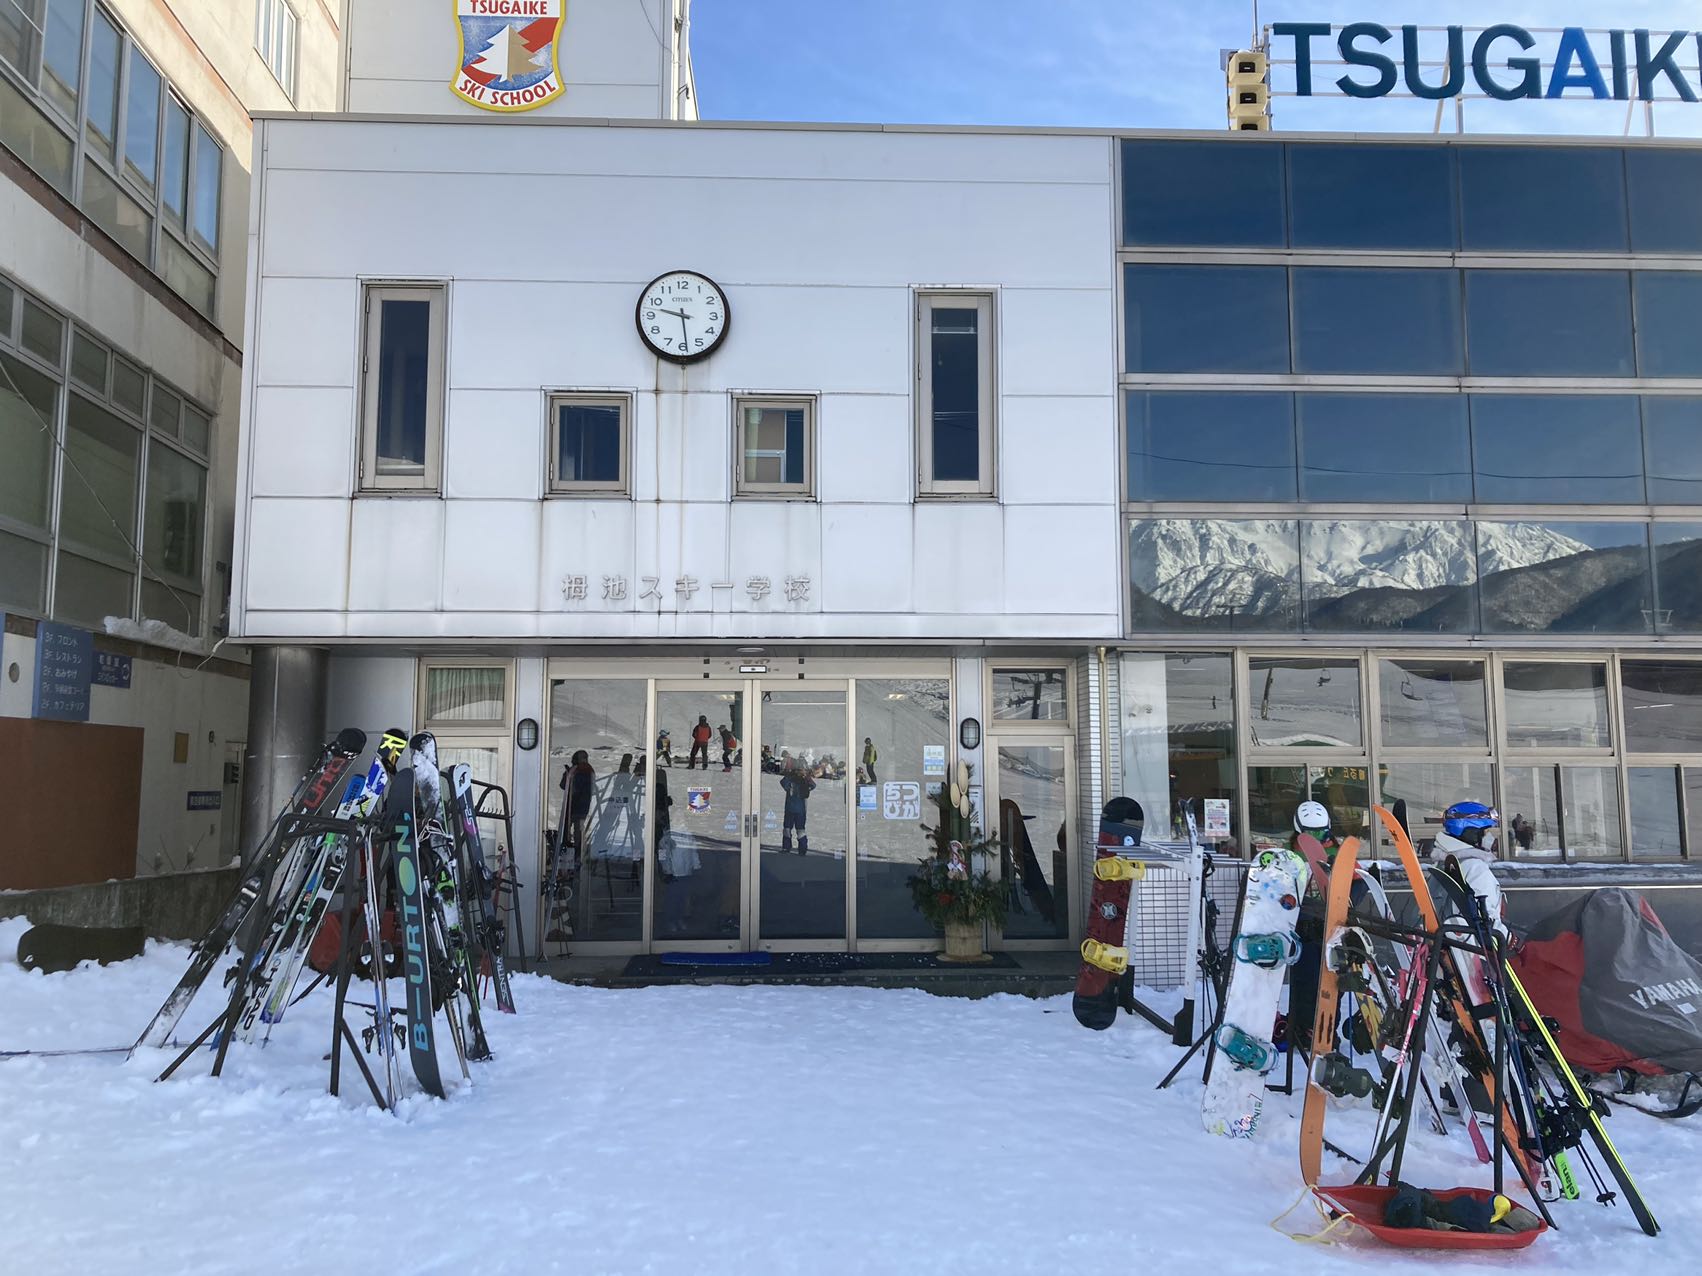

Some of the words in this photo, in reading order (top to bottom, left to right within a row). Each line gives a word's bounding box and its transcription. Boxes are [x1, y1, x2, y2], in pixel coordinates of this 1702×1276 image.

[470, 0, 547, 15] TSUGAIKE
[1273, 22, 1702, 102] TSUGAIK
[459, 79, 486, 101] SKI
[490, 80, 556, 106] SCHOOL
[661, 285, 671, 294] 11
[677, 281, 689, 290] 12
[650, 297, 663, 306] 10
[706, 296, 715, 305] 2
[646, 311, 655, 320] 9
[709, 312, 718, 320] 3
[651, 326, 660, 334] 8
[705, 326, 715, 334] 4
[663, 337, 673, 346] 7
[695, 338, 704, 346] 5
[678, 342, 688, 351] 6
[561, 574, 812, 601] 栂池スキー学校
[1628, 977, 1702, 1010] YAMAHA
